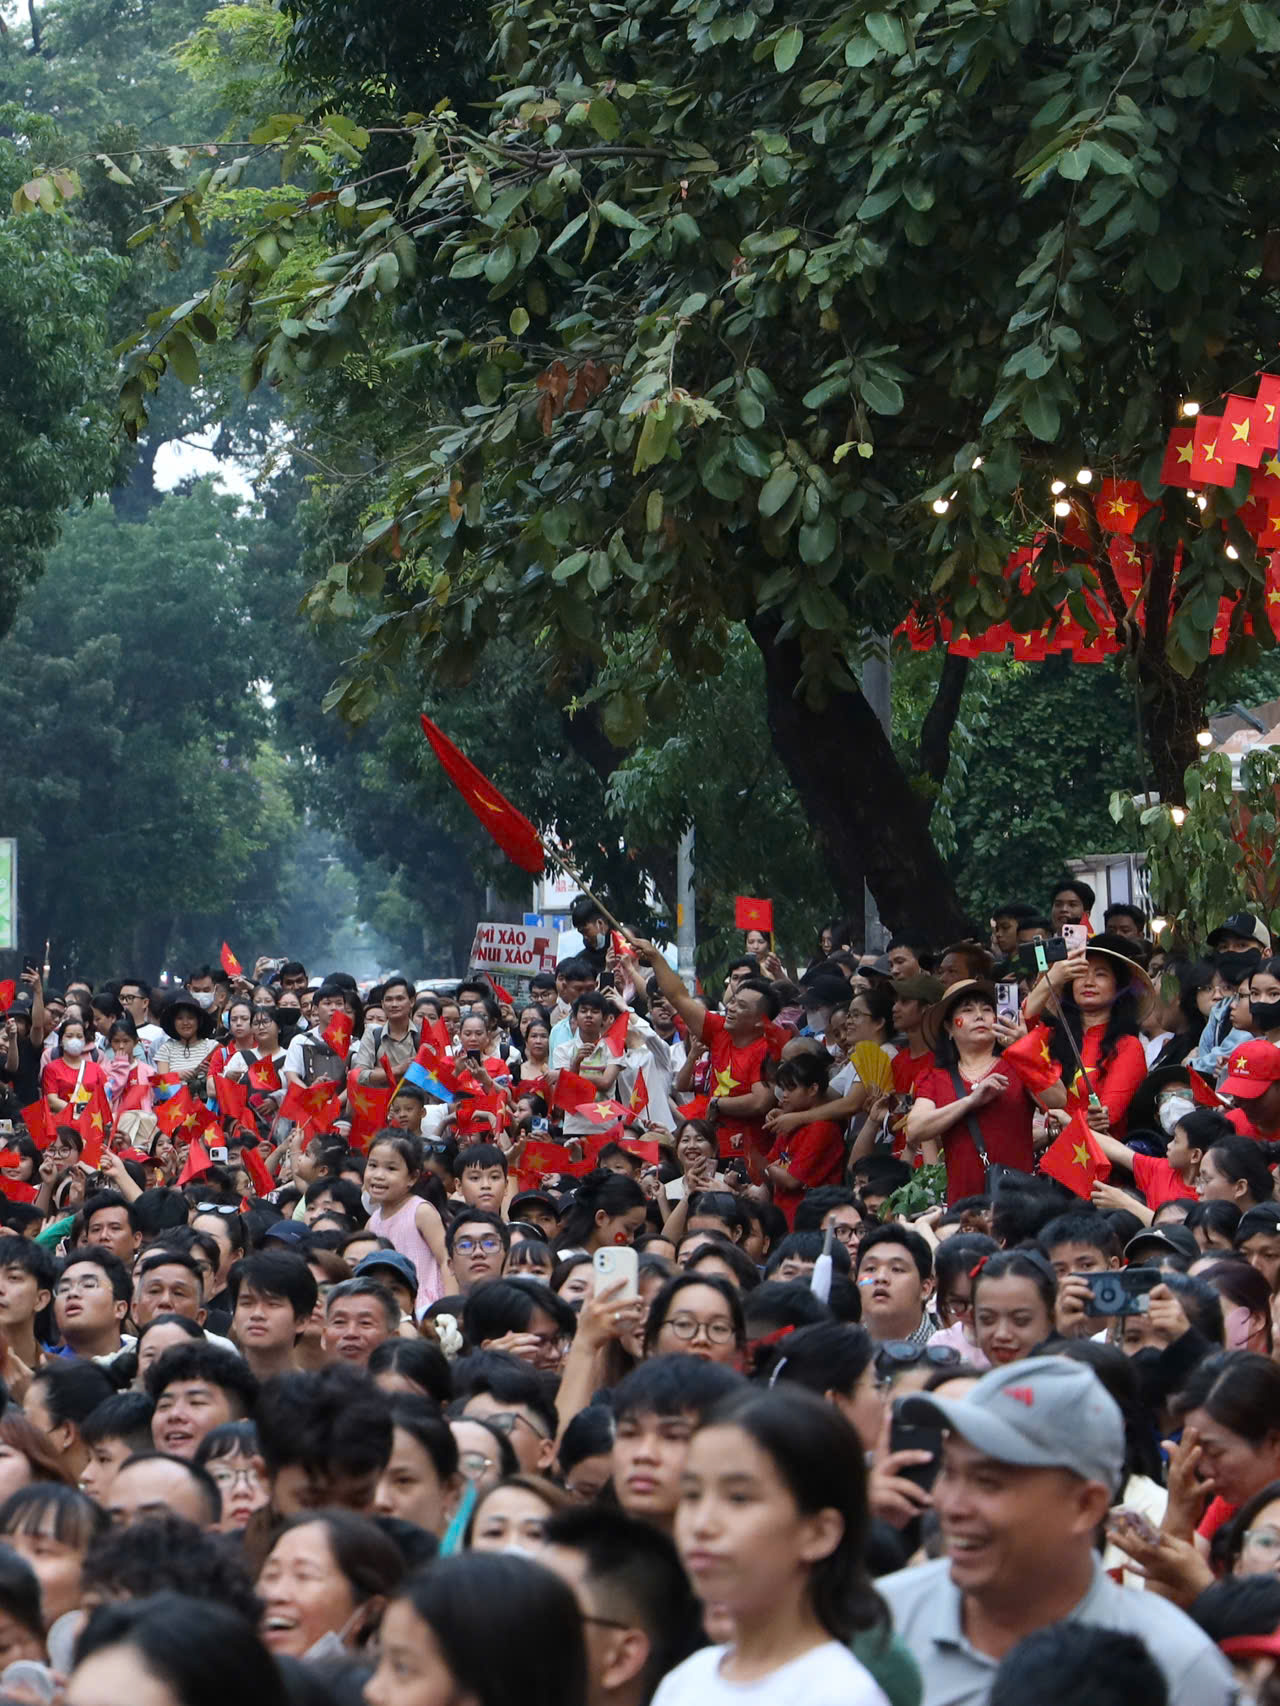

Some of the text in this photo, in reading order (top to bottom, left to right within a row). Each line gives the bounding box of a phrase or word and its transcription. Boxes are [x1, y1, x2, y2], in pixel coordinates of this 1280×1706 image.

[498, 928, 526, 946] XÀO
[478, 947, 533, 964] NUI XÀO
